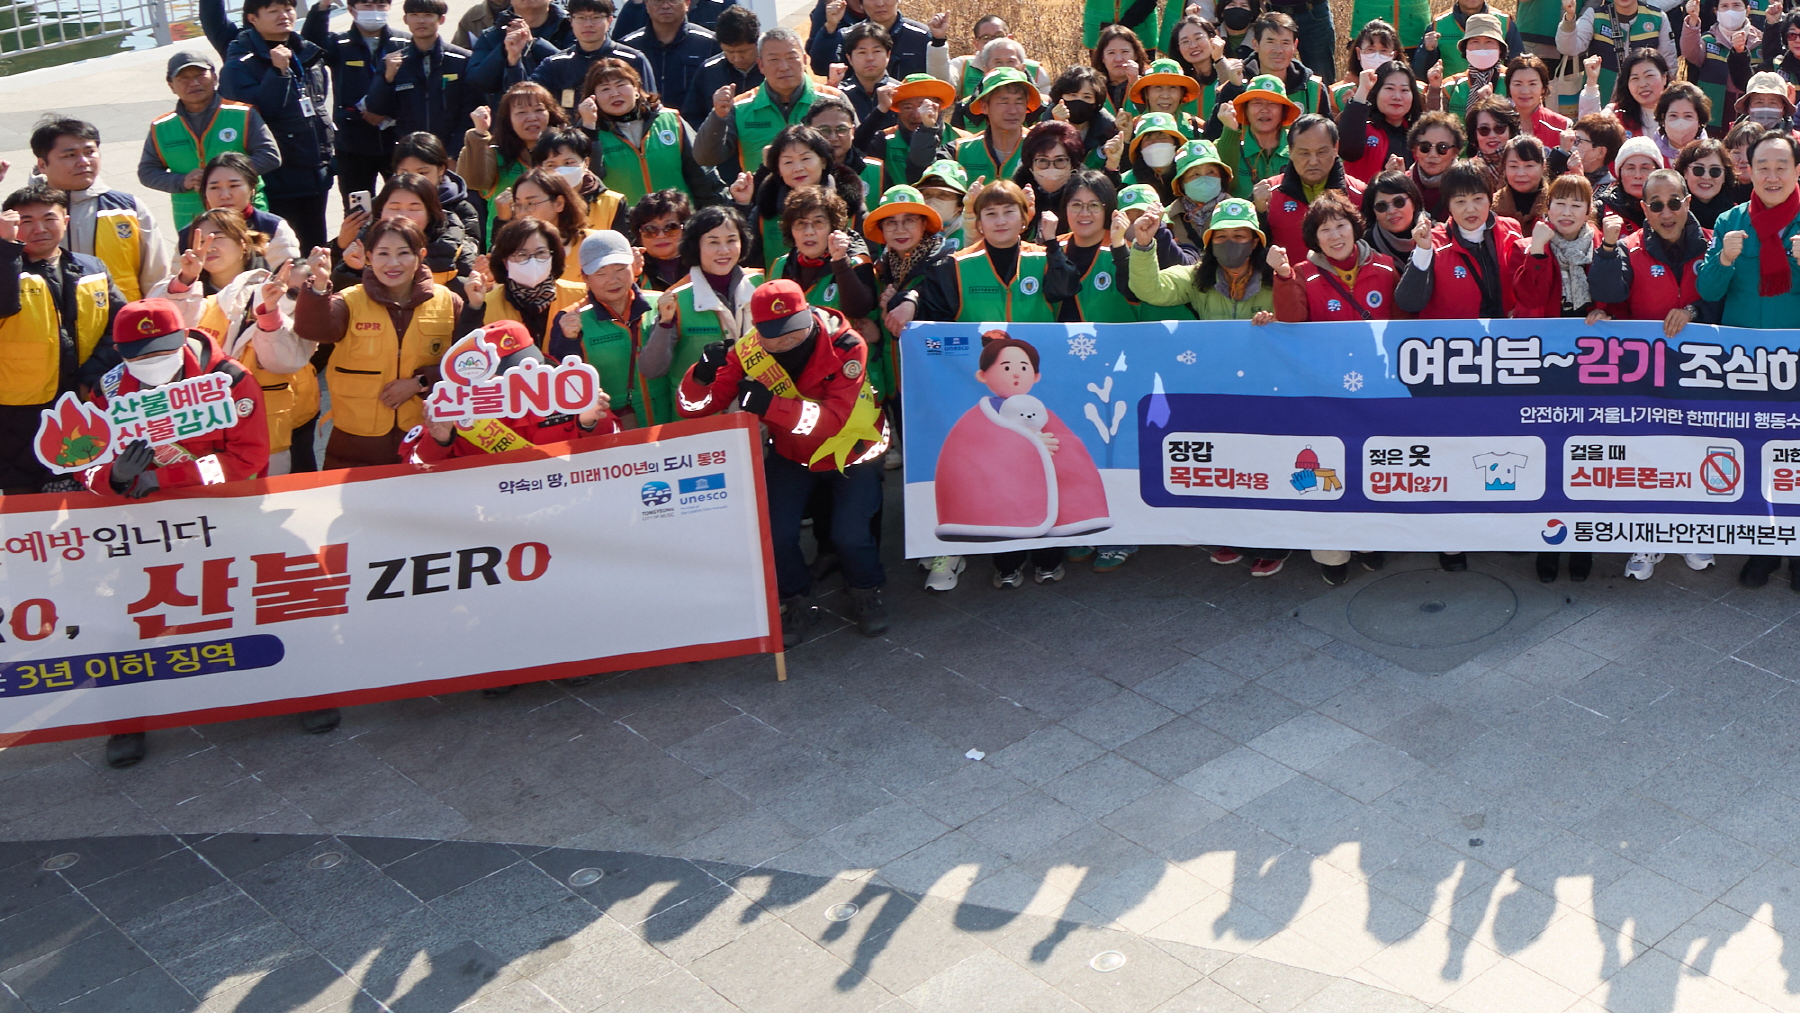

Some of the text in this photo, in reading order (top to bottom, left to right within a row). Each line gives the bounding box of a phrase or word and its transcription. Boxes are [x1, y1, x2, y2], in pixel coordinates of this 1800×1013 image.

[355, 322, 382, 332] CPR
[110, 377, 228, 426] 산불예방
[432, 369, 593, 419] 산불 NO
[117, 401, 233, 449] 산불감시
[1520, 406, 1584, 425] 안전하게
[1588, 406, 1684, 426] 겨울나기위한
[1687, 410, 1750, 430] 한파대비
[477, 420, 506, 449] 소각
[1168, 441, 1214, 464] 장갑
[1369, 444, 1431, 467] 젖은 옷
[1570, 443, 1627, 462] 걸을 때
[498, 478, 544, 495] 약속의
[546, 472, 568, 489] 땅,
[663, 454, 694, 473] 도시
[697, 450, 728, 468] 통영
[1169, 466, 1270, 491] 목도리착용
[1370, 471, 1449, 495] 입지않기
[1570, 465, 1692, 490] 스마트폰금지
[680, 491, 728, 505] unesco
[641, 507, 675, 517] TONGYEONG
[0, 515, 218, 565] 예방입니다
[1573, 521, 1798, 546] 통영시재난안전대책본부
[127, 541, 553, 640] 산불 ZERO
[18, 642, 237, 690] 3년 이하 징역
